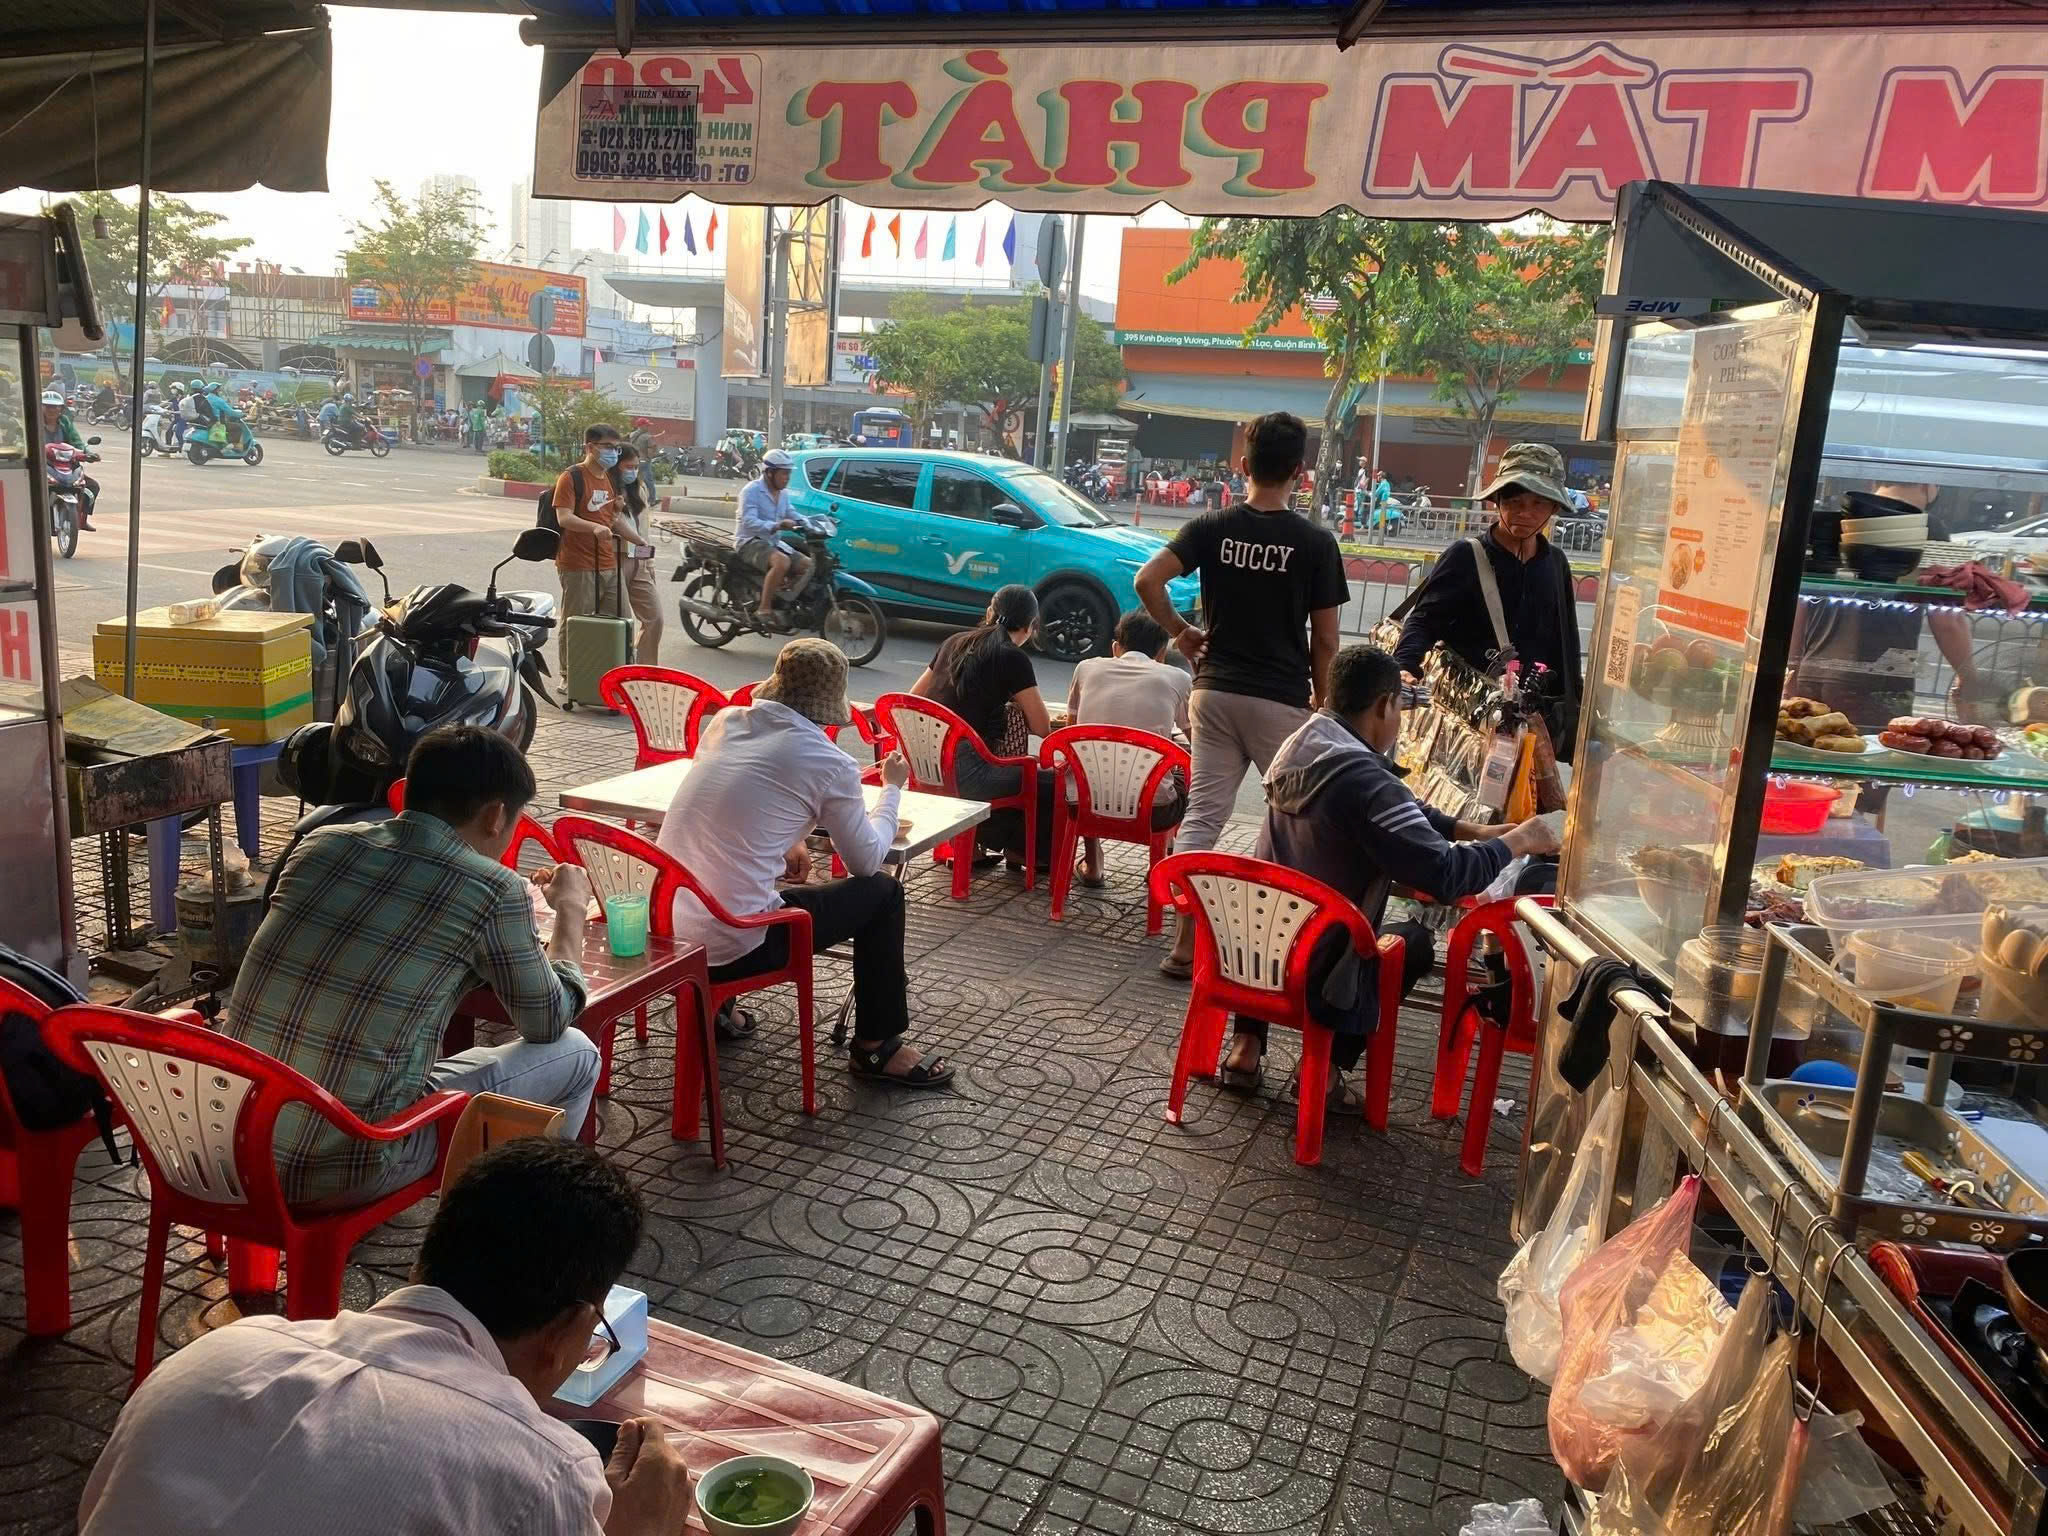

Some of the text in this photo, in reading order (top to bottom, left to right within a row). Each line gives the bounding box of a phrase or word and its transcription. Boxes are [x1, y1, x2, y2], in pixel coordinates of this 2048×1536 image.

[578, 151, 693, 175] 0903.348.646
[1625, 300, 1680, 313] MPE
[1124, 333, 1138, 341] 395
[1140, 334, 1155, 342] Kinh
[631, 377, 659, 386] SAMCO
[1220, 537, 1295, 573] GUCCY
